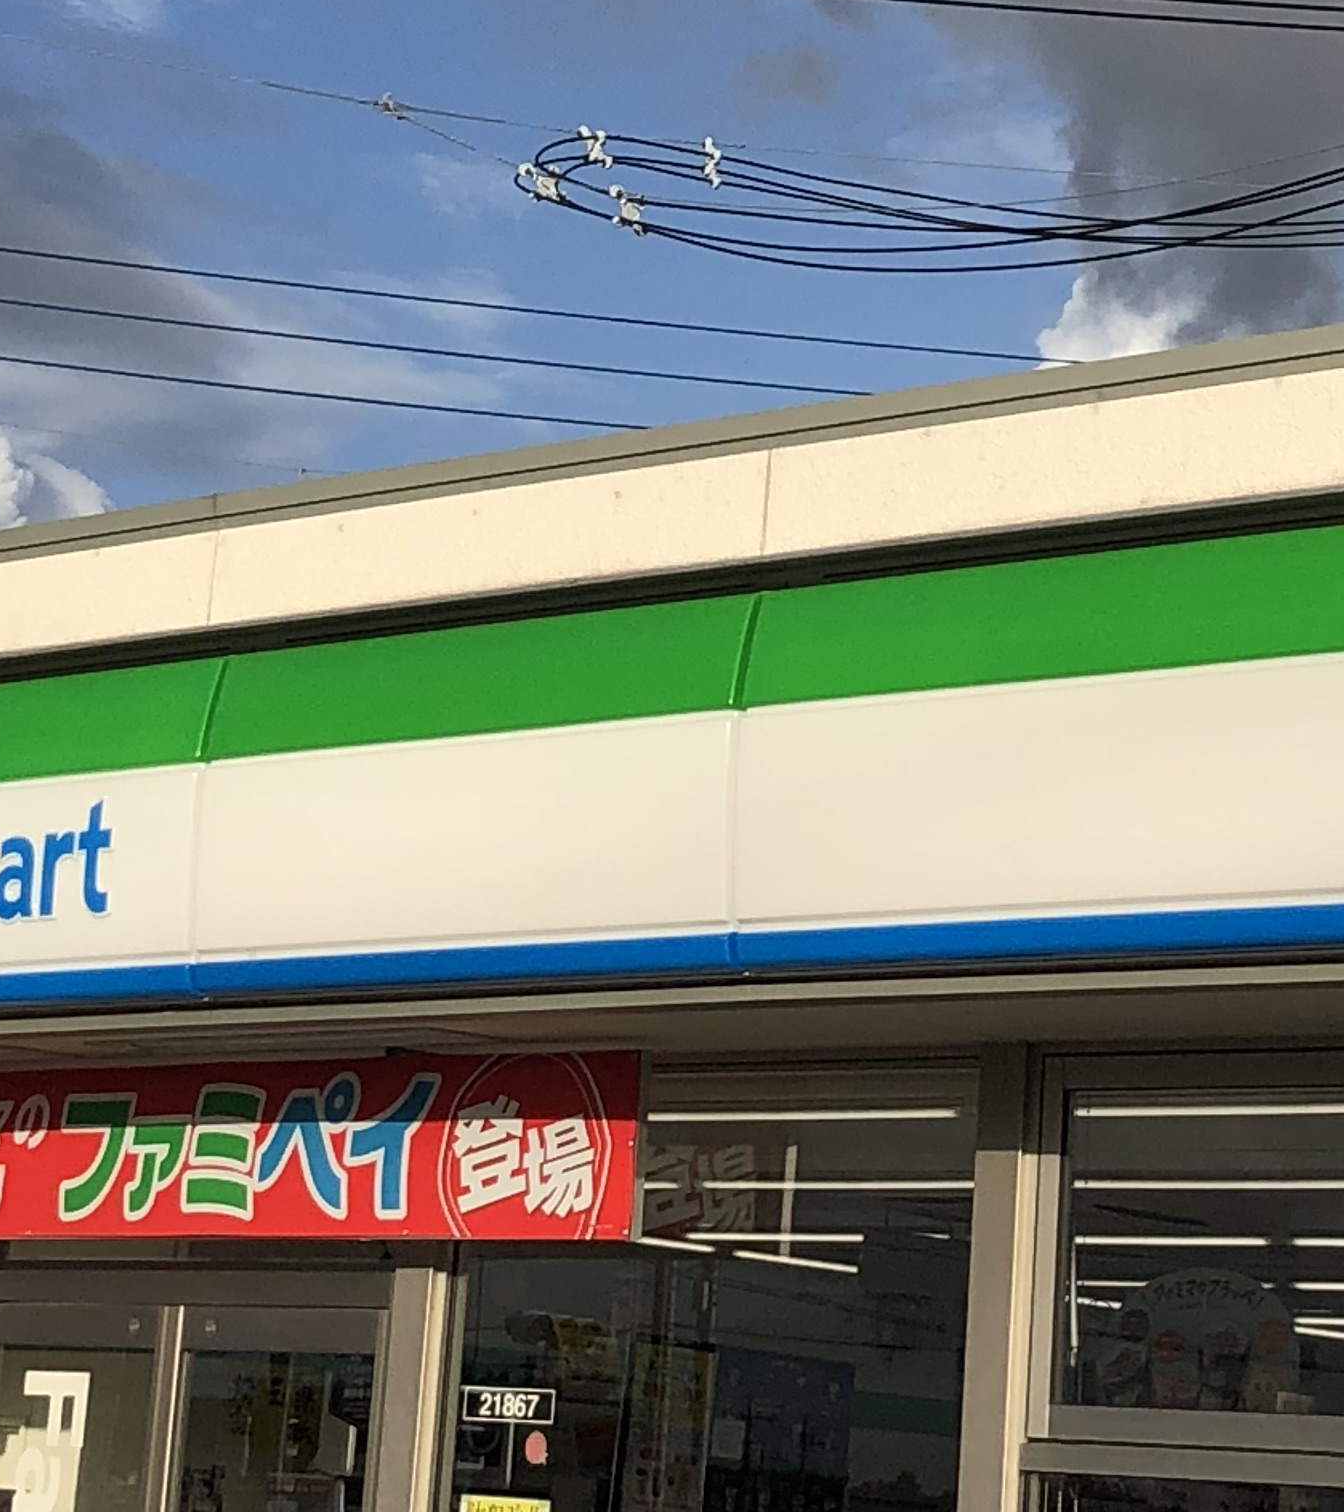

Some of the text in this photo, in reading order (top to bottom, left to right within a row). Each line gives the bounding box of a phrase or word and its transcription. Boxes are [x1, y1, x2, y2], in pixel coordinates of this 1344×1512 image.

[59, 1071, 442, 1222] ファミペイ
[452, 1094, 596, 1218] 登場
[478, 1392, 540, 1418] 21867
